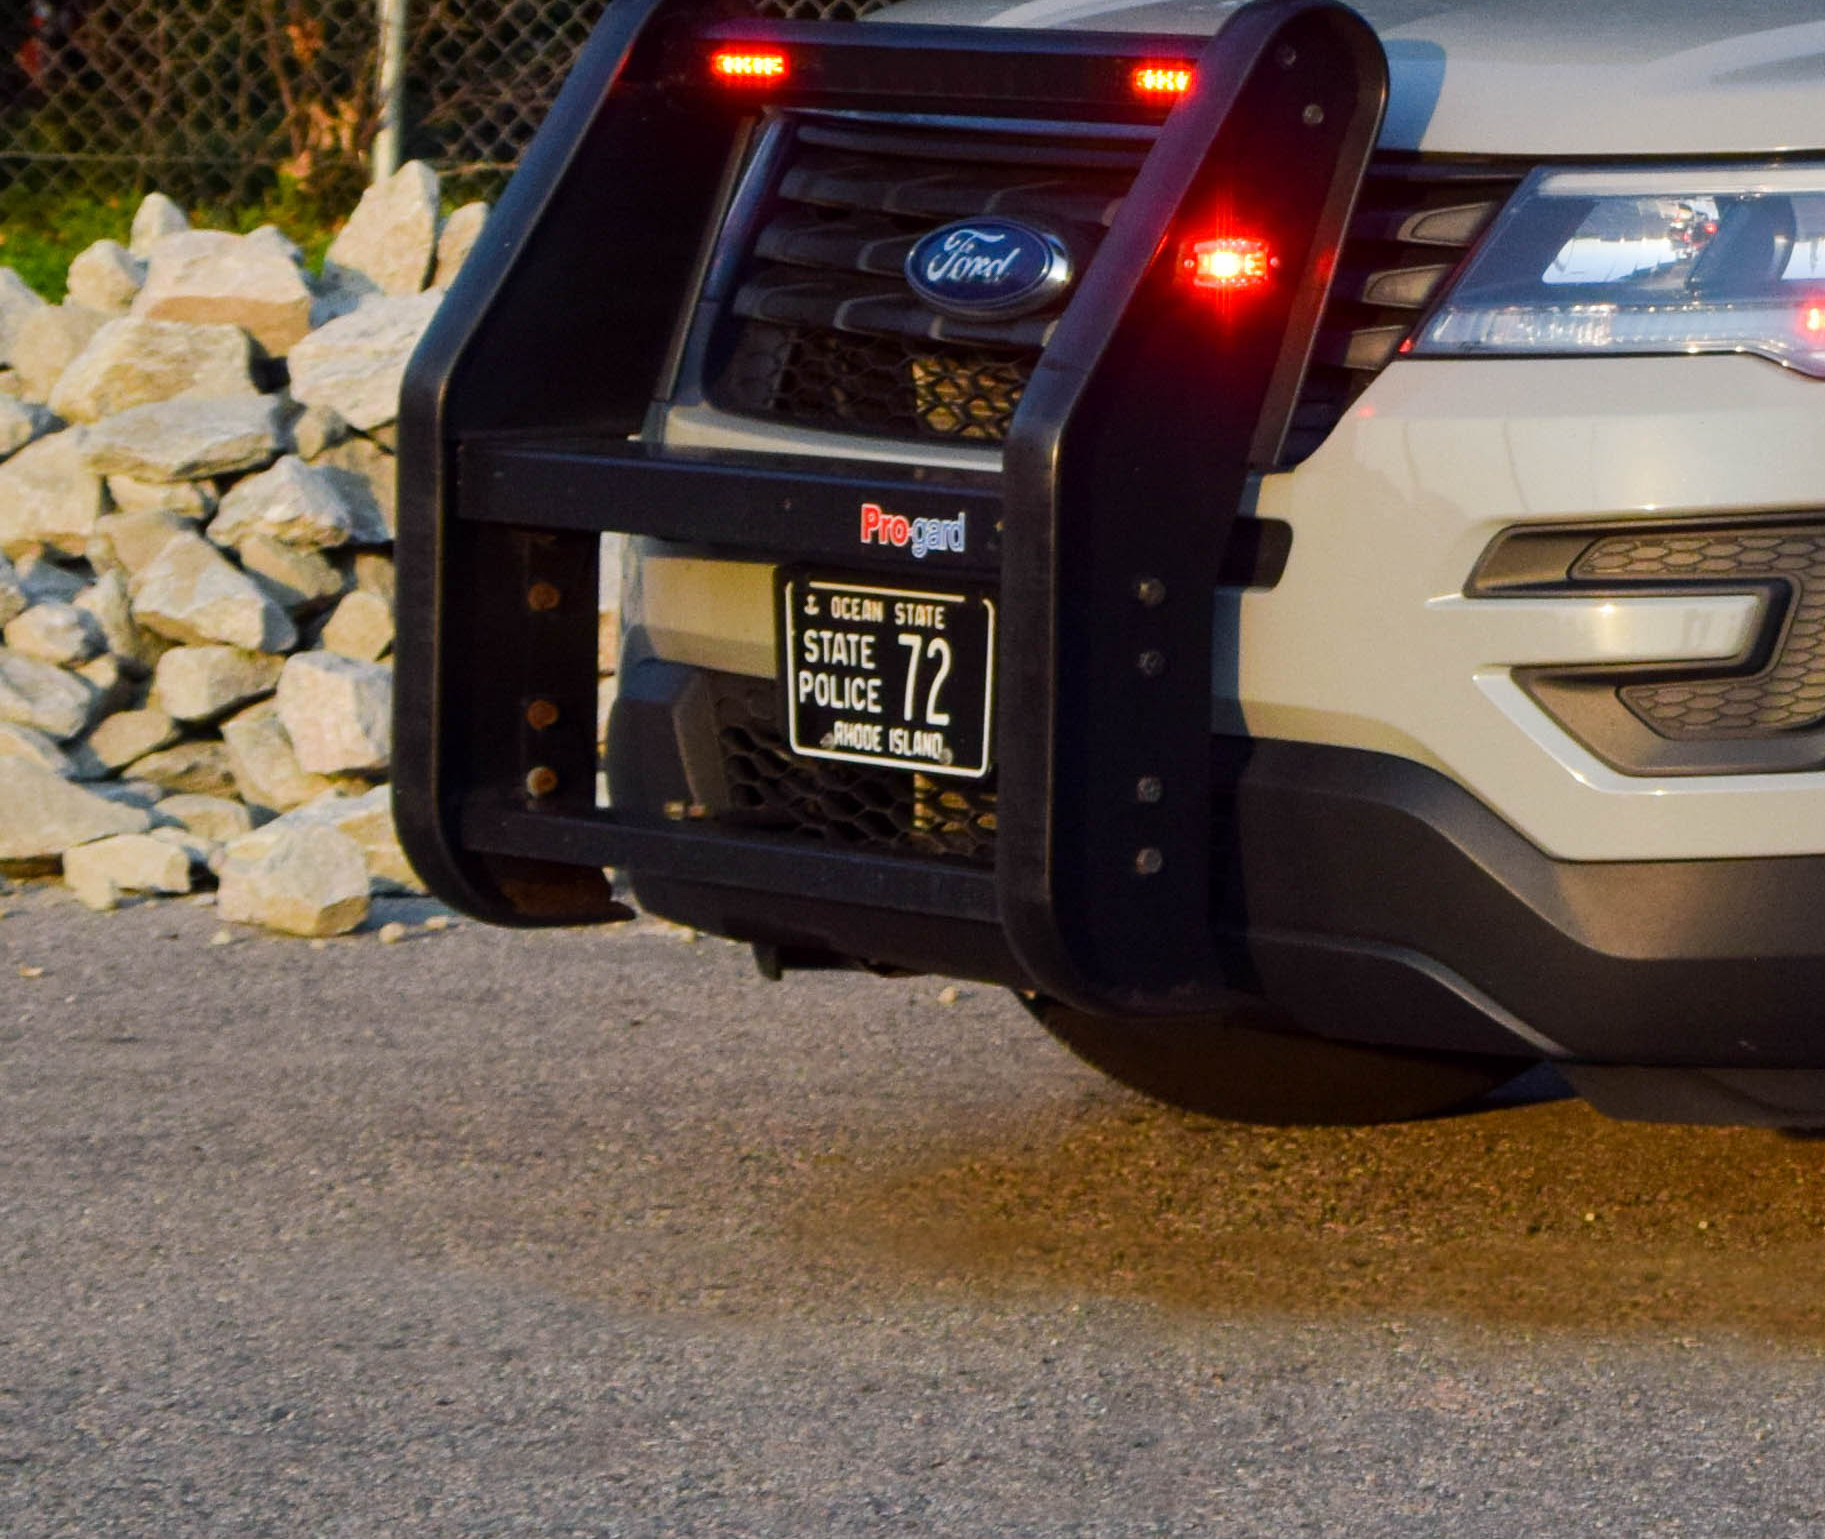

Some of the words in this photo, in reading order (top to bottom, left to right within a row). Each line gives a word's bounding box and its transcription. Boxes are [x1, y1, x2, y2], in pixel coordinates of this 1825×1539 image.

[926, 228, 1021, 284] Ford
[831, 595, 884, 623] OCEAN
[894, 603, 946, 631] STATE
[803, 630, 876, 670] STATE
[799, 670, 883, 714] POLICE
[898, 634, 951, 727] 72
[833, 720, 883, 751] RHODE
[889, 728, 944, 759] ISLAND
